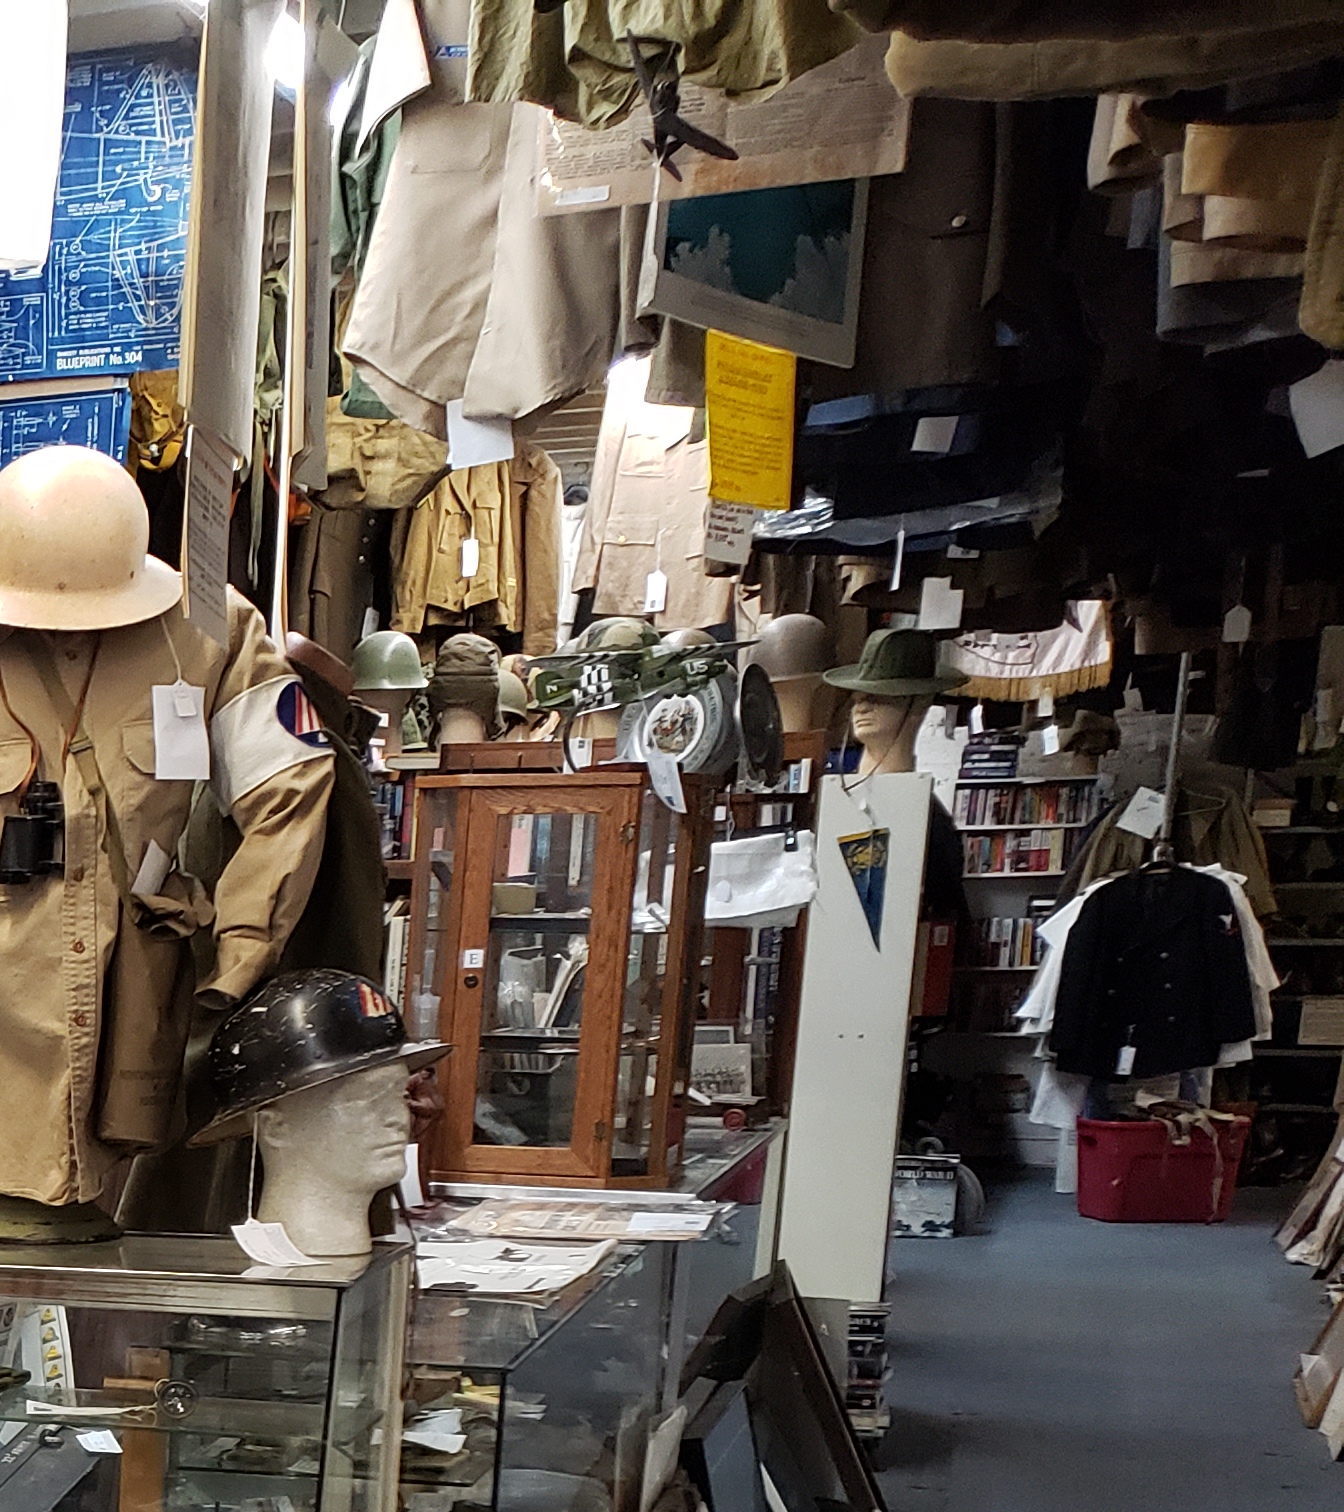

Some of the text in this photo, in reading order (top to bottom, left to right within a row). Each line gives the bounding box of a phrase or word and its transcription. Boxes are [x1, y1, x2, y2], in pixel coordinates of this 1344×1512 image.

[56, 354, 106, 371] BLUEPRINT
[685, 660, 709, 675] US
[469, 953, 480, 965] E
[895, 1170, 923, 1179] ORLD
